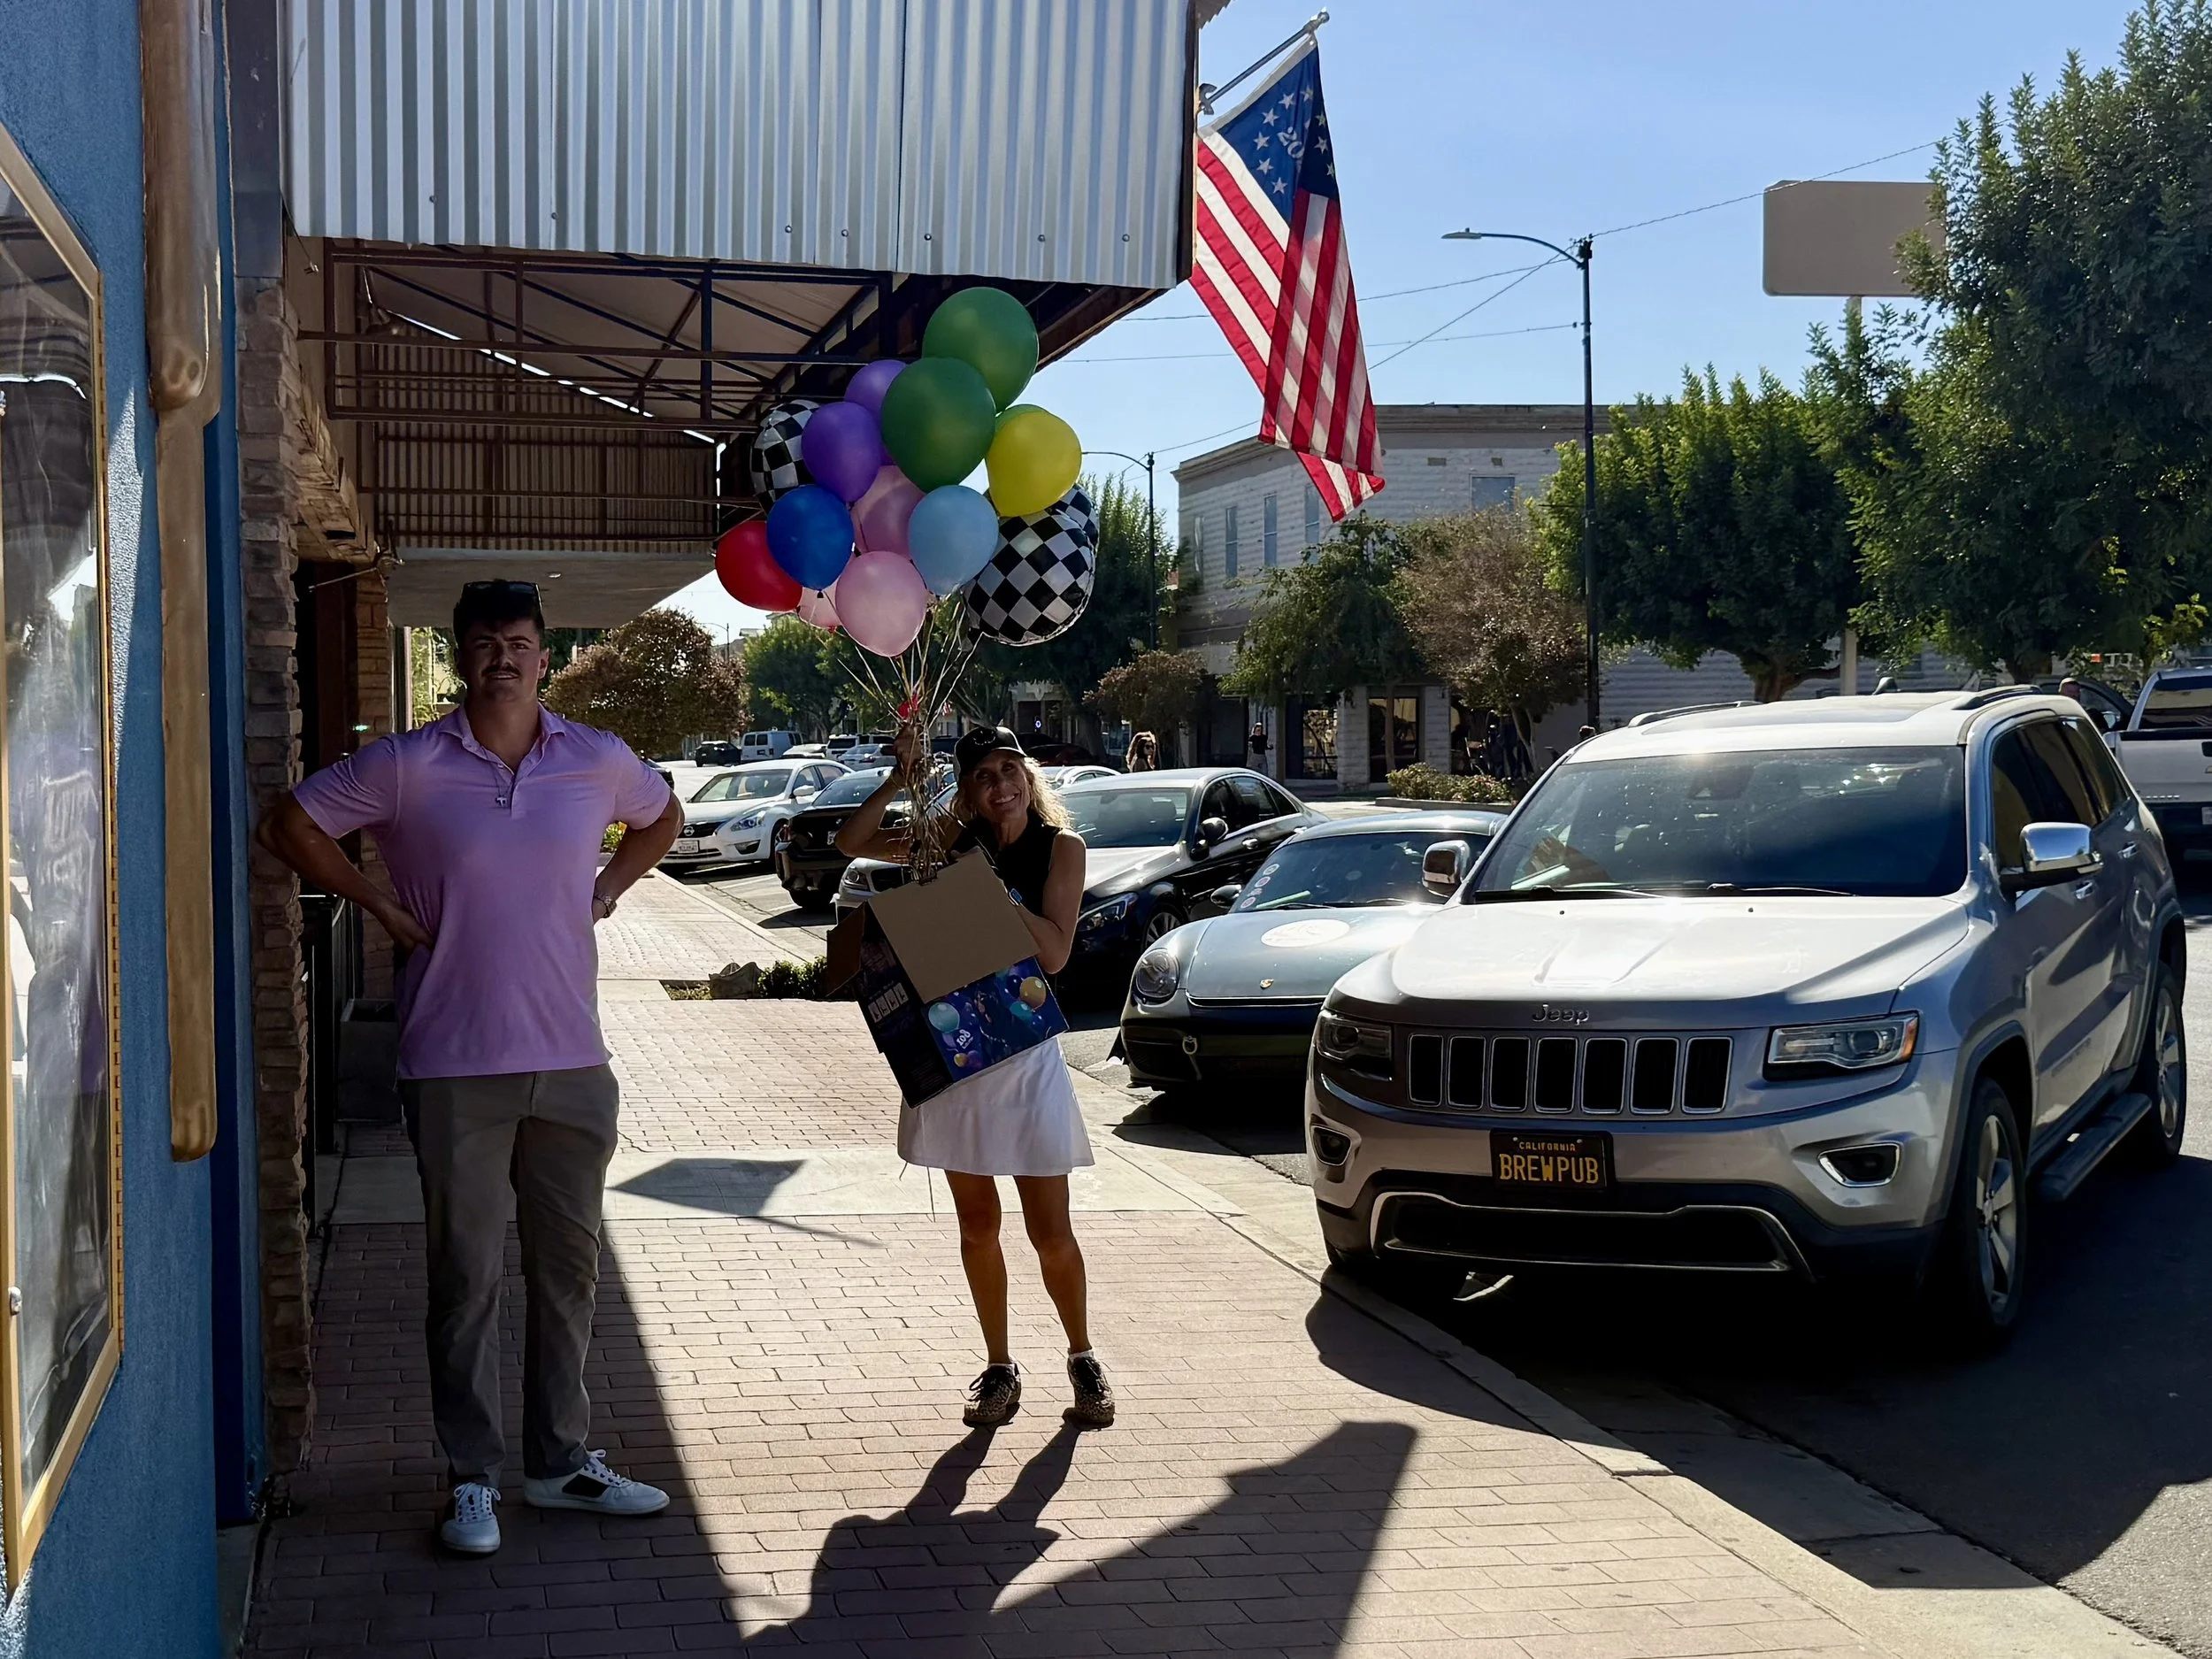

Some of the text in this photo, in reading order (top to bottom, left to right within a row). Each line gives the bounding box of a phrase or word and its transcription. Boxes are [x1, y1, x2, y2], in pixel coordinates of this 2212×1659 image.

[1532, 1003, 1590, 1026] Jeep
[1518, 1141, 1576, 1151] CALIFORNIA
[1499, 1153, 1599, 1184] BREWPUB
